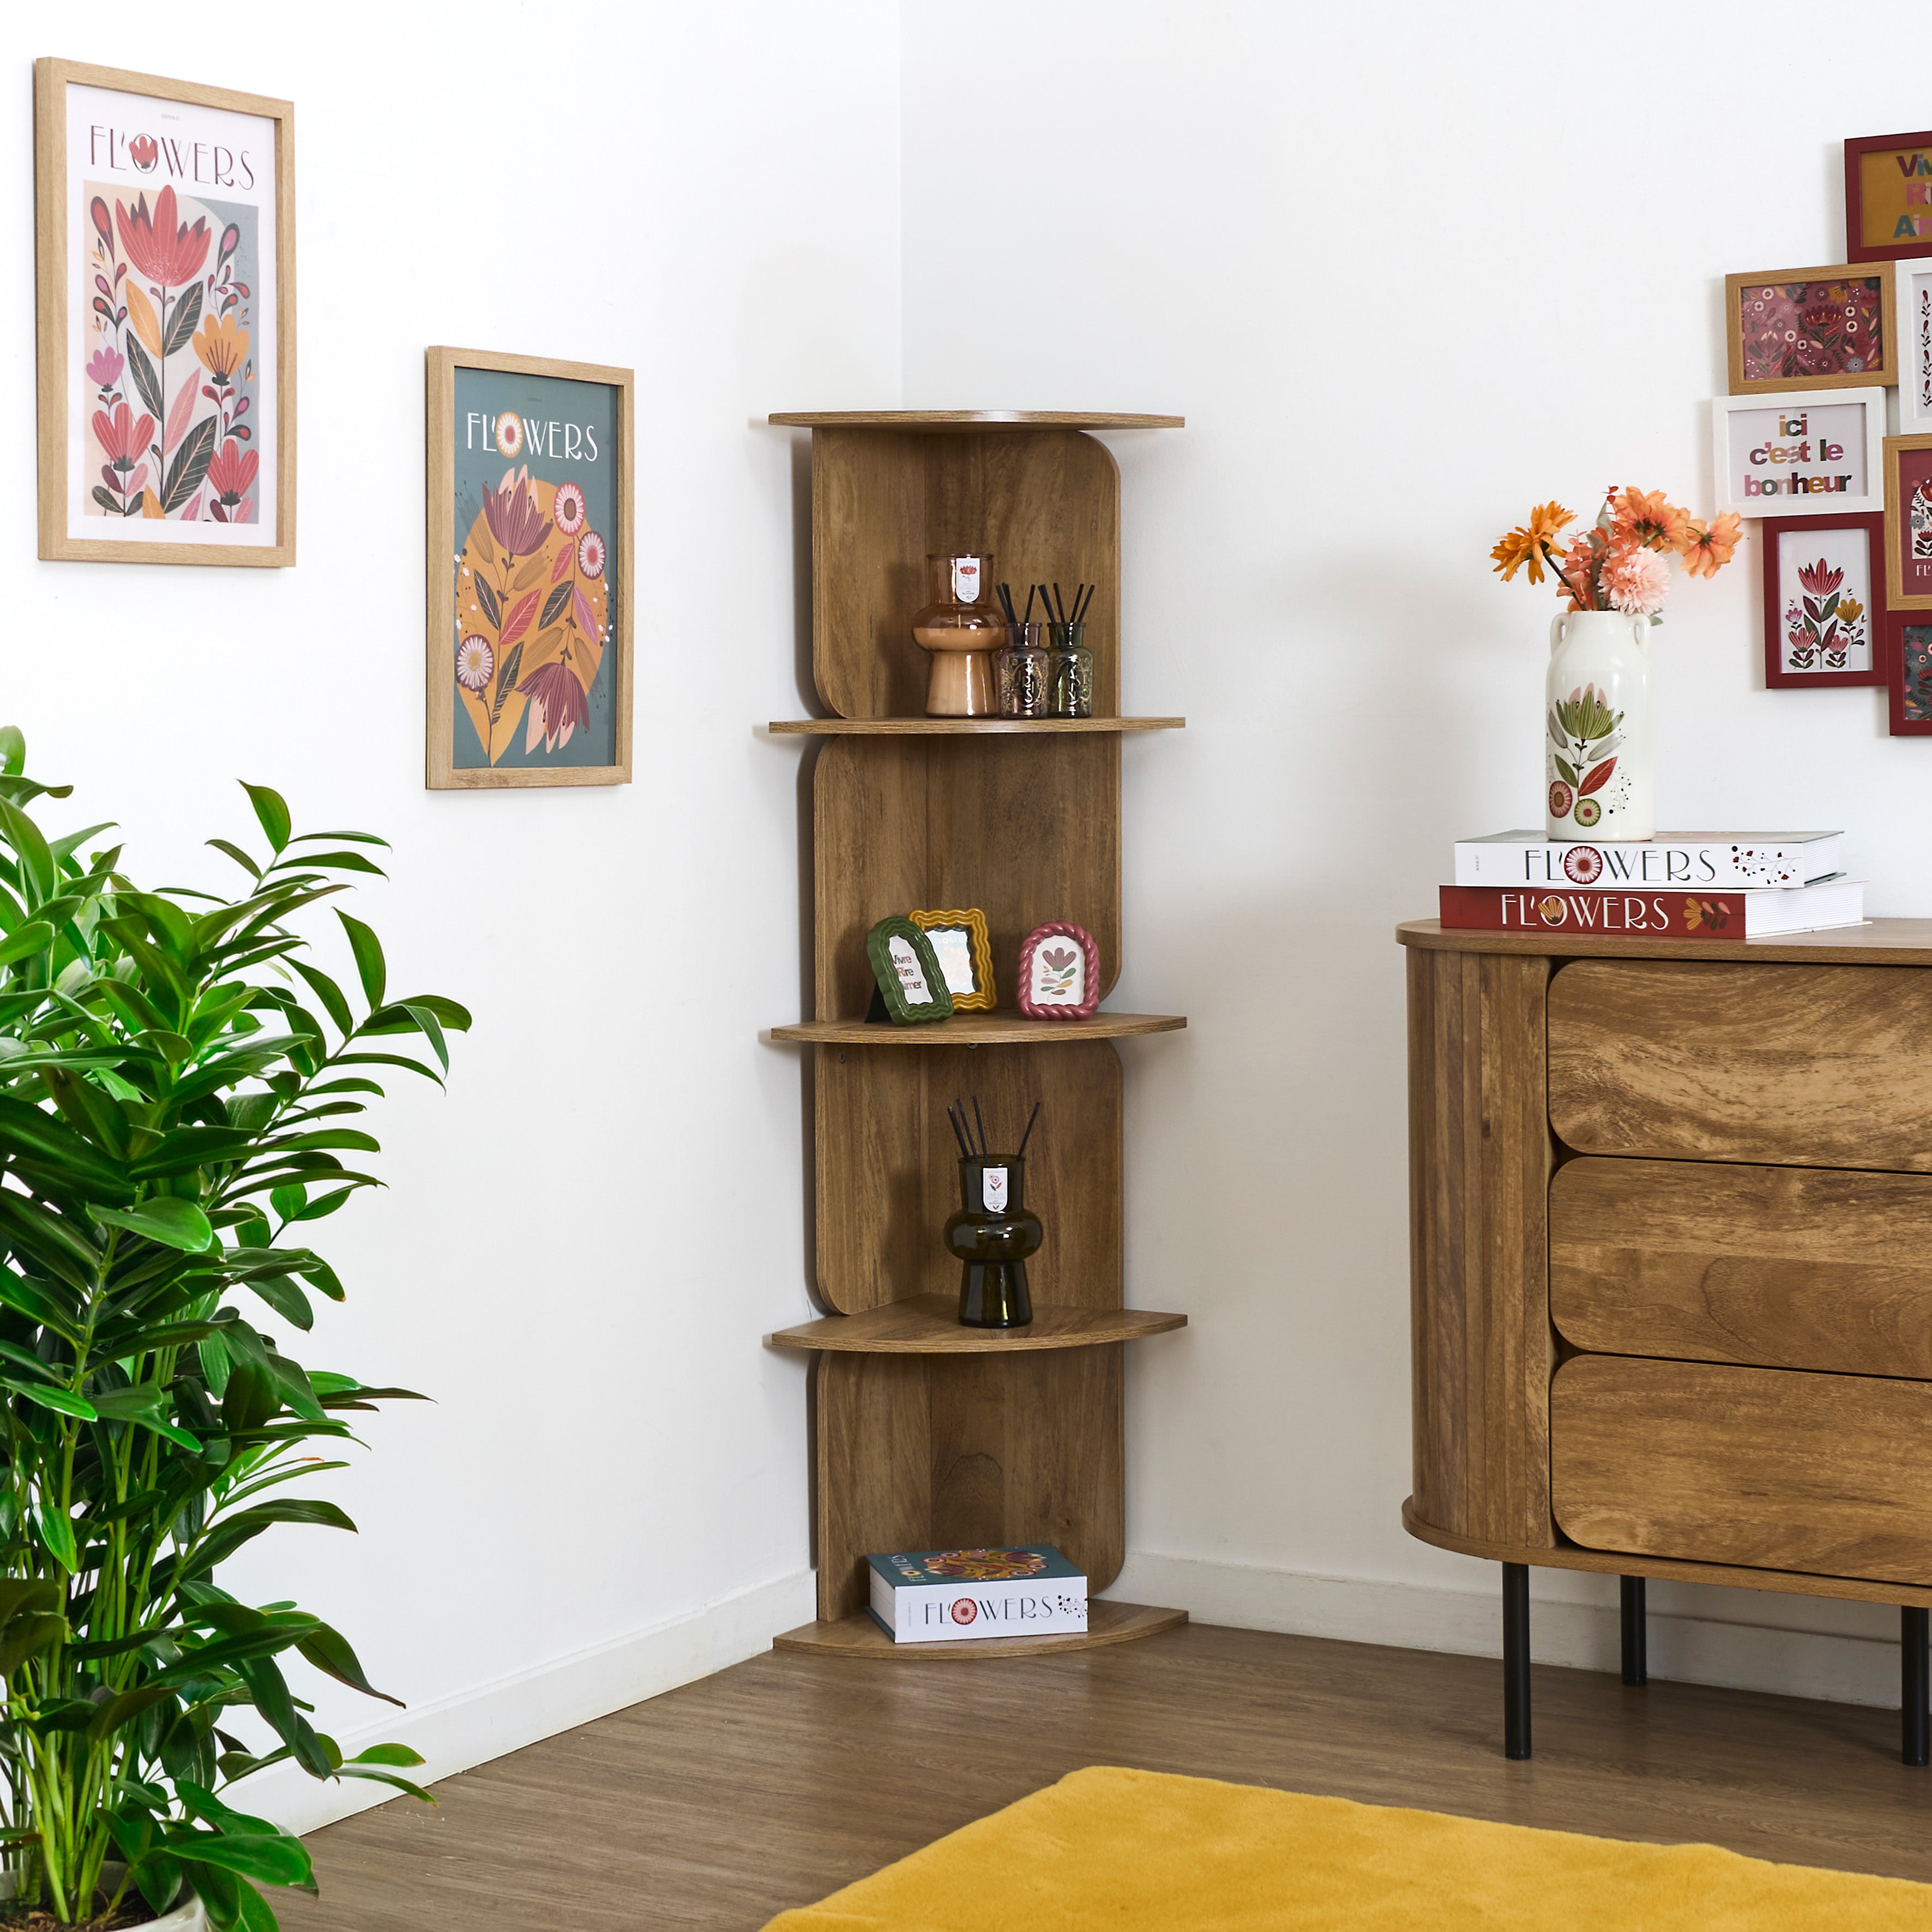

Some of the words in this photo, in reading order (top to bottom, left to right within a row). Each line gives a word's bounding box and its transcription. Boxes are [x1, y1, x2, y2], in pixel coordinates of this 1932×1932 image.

[1779, 413, 1808, 437] ici
[1749, 441, 1811, 465] c'est
[1820, 439, 1844, 461] le
[1744, 472, 1852, 497] bonheur
[903, 980, 922, 990] imer
